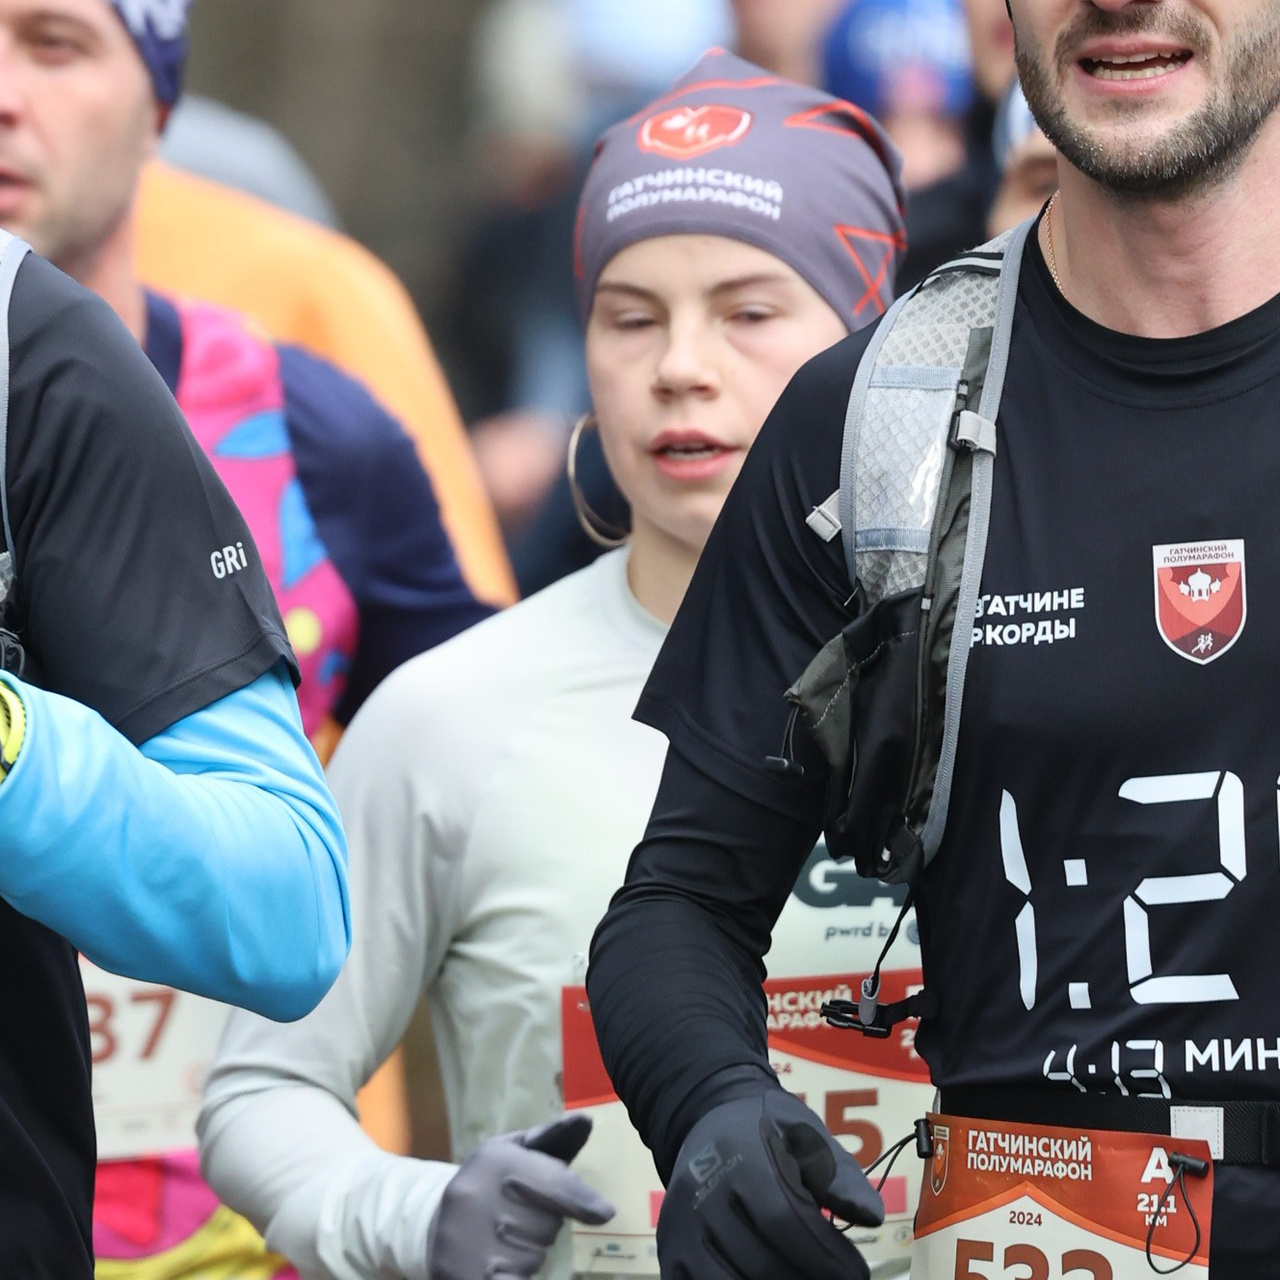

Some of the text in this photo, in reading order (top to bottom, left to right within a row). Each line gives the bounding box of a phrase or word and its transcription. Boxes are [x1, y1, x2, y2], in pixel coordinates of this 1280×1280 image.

[608, 166, 783, 204] ГАТЧИНСКИЙ
[606, 188, 781, 222] ПОЛУМАРАФОН
[210, 541, 248, 580] GRi
[1163, 552, 1235, 563] ПОЛУМАРАФОН
[1169, 543, 1227, 556] ГАТЧИНСКИЙ
[970, 617, 1076, 648] РКОРДЫ
[999, 770, 1280, 1011] 1:2
[1043, 1039, 1172, 1100] 4:13
[967, 1129, 1093, 1162] ГАТЧИНСКИЙ
[966, 1152, 1093, 1182] ПОЛУМАРАФОН
[1009, 1210, 1043, 1227] 2024
[1136, 1193, 1178, 1214] 21.1
[1144, 1213, 1168, 1227] КМ
